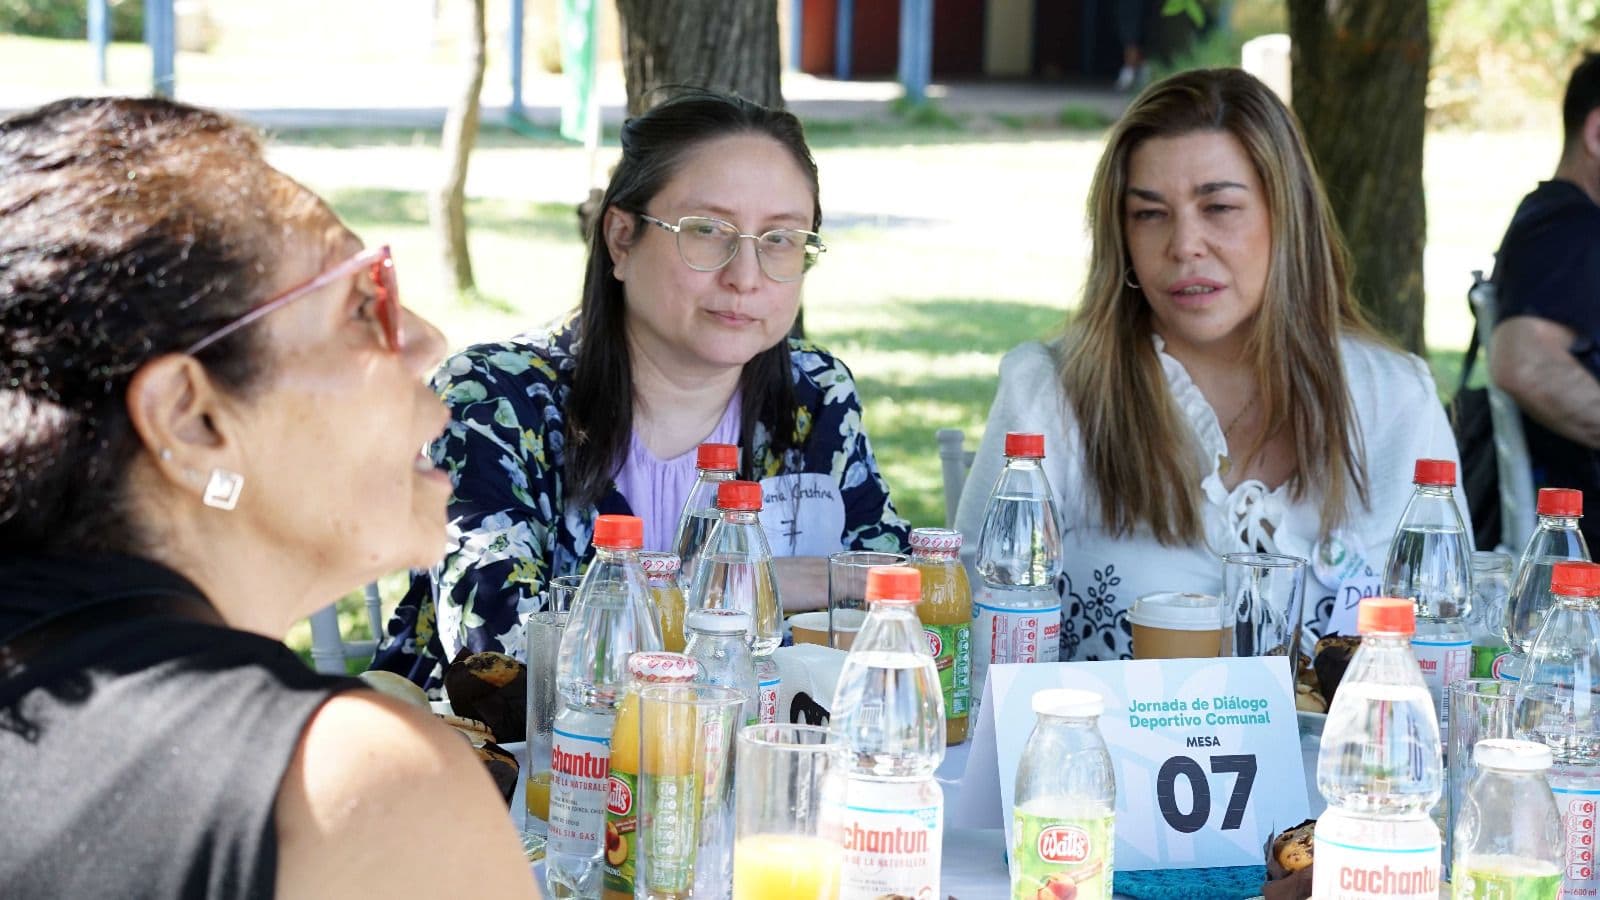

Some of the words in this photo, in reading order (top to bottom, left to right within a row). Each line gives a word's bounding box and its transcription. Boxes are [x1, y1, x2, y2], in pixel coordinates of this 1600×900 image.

[1417, 657, 1437, 671] ntun
[1129, 698, 1187, 713] Jornada
[1191, 697, 1210, 711] de
[1213, 695, 1268, 711] Diálogo
[1129, 712, 1202, 730] Deportivo
[1205, 711, 1271, 726] Comunal
[1186, 736, 1221, 748] MESA
[1156, 754, 1258, 834] 07
[842, 821, 928, 854] chantun
[1339, 864, 1438, 896] cachantu
